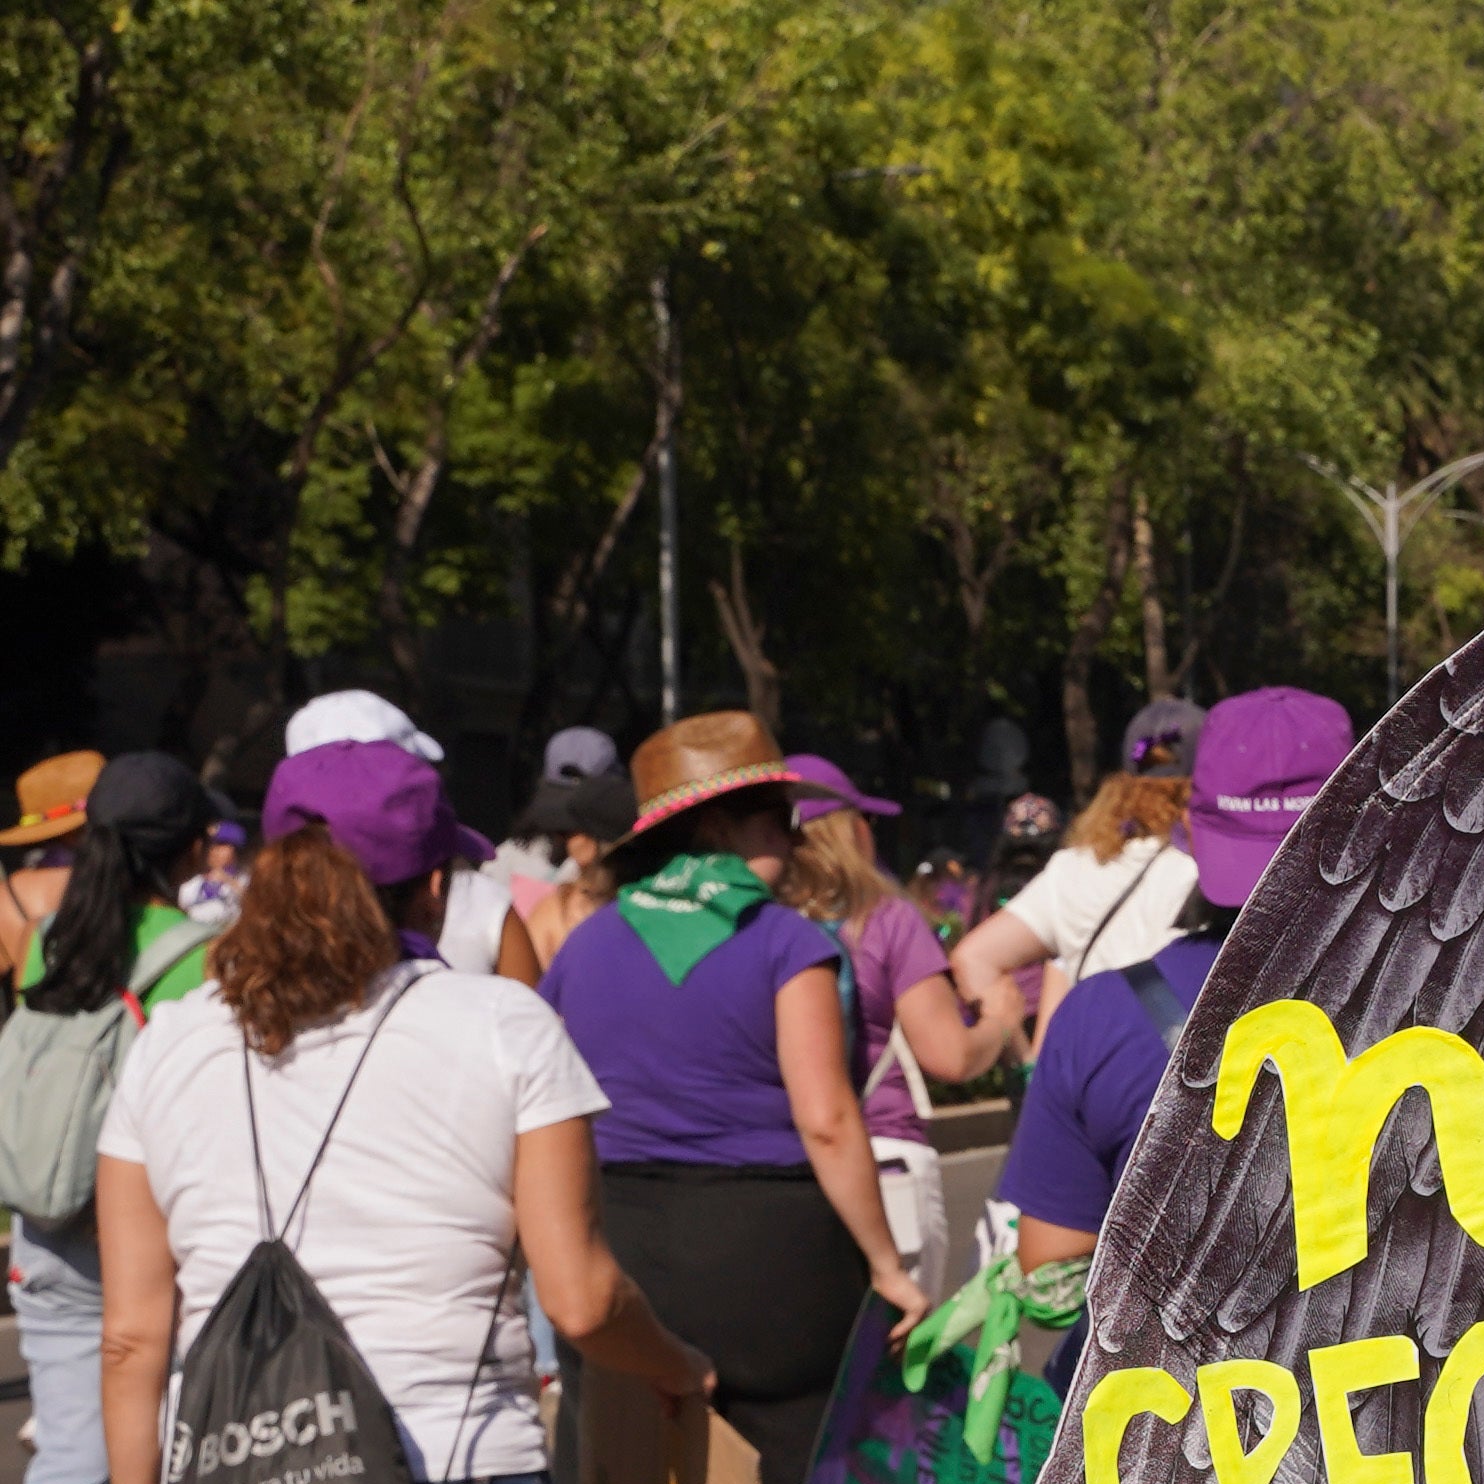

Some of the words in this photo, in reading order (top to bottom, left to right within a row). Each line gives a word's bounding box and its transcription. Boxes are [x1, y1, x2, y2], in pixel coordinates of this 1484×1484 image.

[1253, 797, 1280, 812] LAS
[197, 1390, 357, 1477] BOSCH
[313, 1452, 366, 1481] vida
